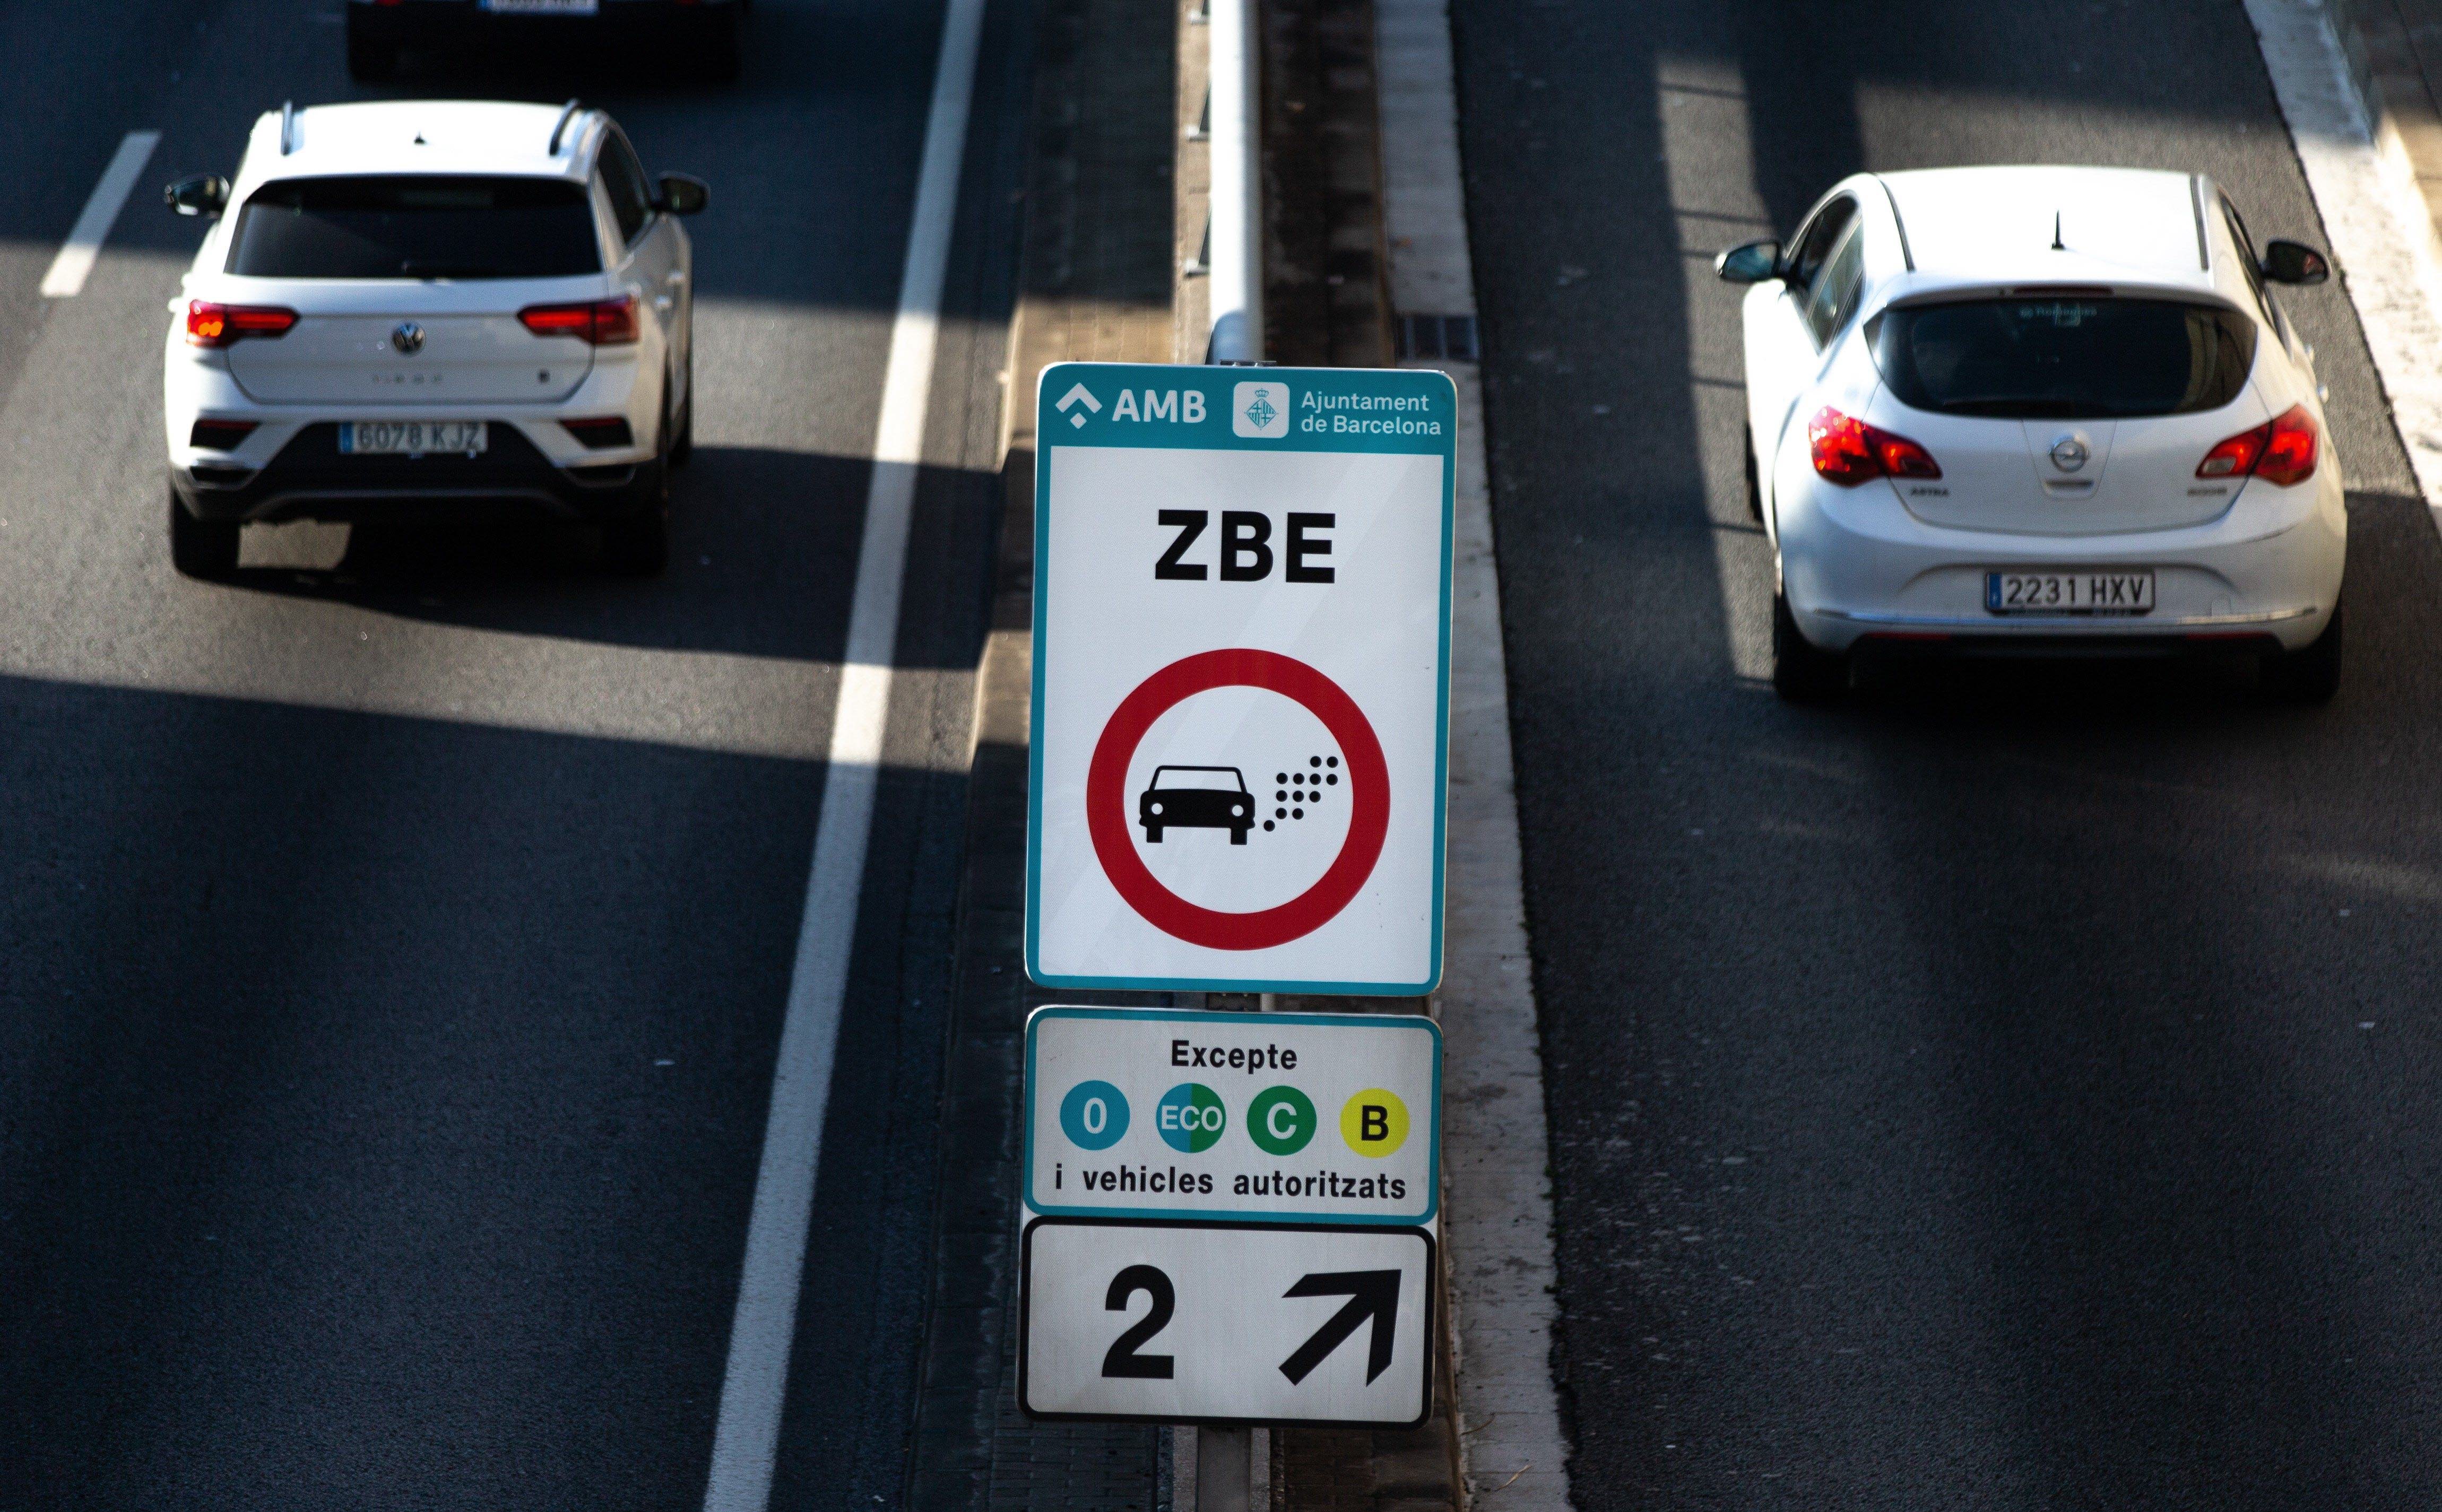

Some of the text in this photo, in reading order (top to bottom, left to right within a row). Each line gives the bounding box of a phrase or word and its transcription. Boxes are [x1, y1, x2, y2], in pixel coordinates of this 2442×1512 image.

[1112, 389, 1207, 423] AMB
[1301, 390, 1430, 413] Ajuntament
[358, 421, 479, 449] 6078 KJZ
[1301, 415, 1442, 436] de Barcelona
[1155, 509, 1336, 584] ZBE
[2007, 577, 2144, 604] 2231 HXV
[1171, 1040, 1297, 1074] Excepte
[1161, 1105, 1223, 1132] ECO
[1267, 1101, 1297, 1140] C
[1361, 1105, 1389, 1141] B
[1055, 1163, 1406, 1200] i vehicles autoritzats
[1101, 1264, 1175, 1380] 2
